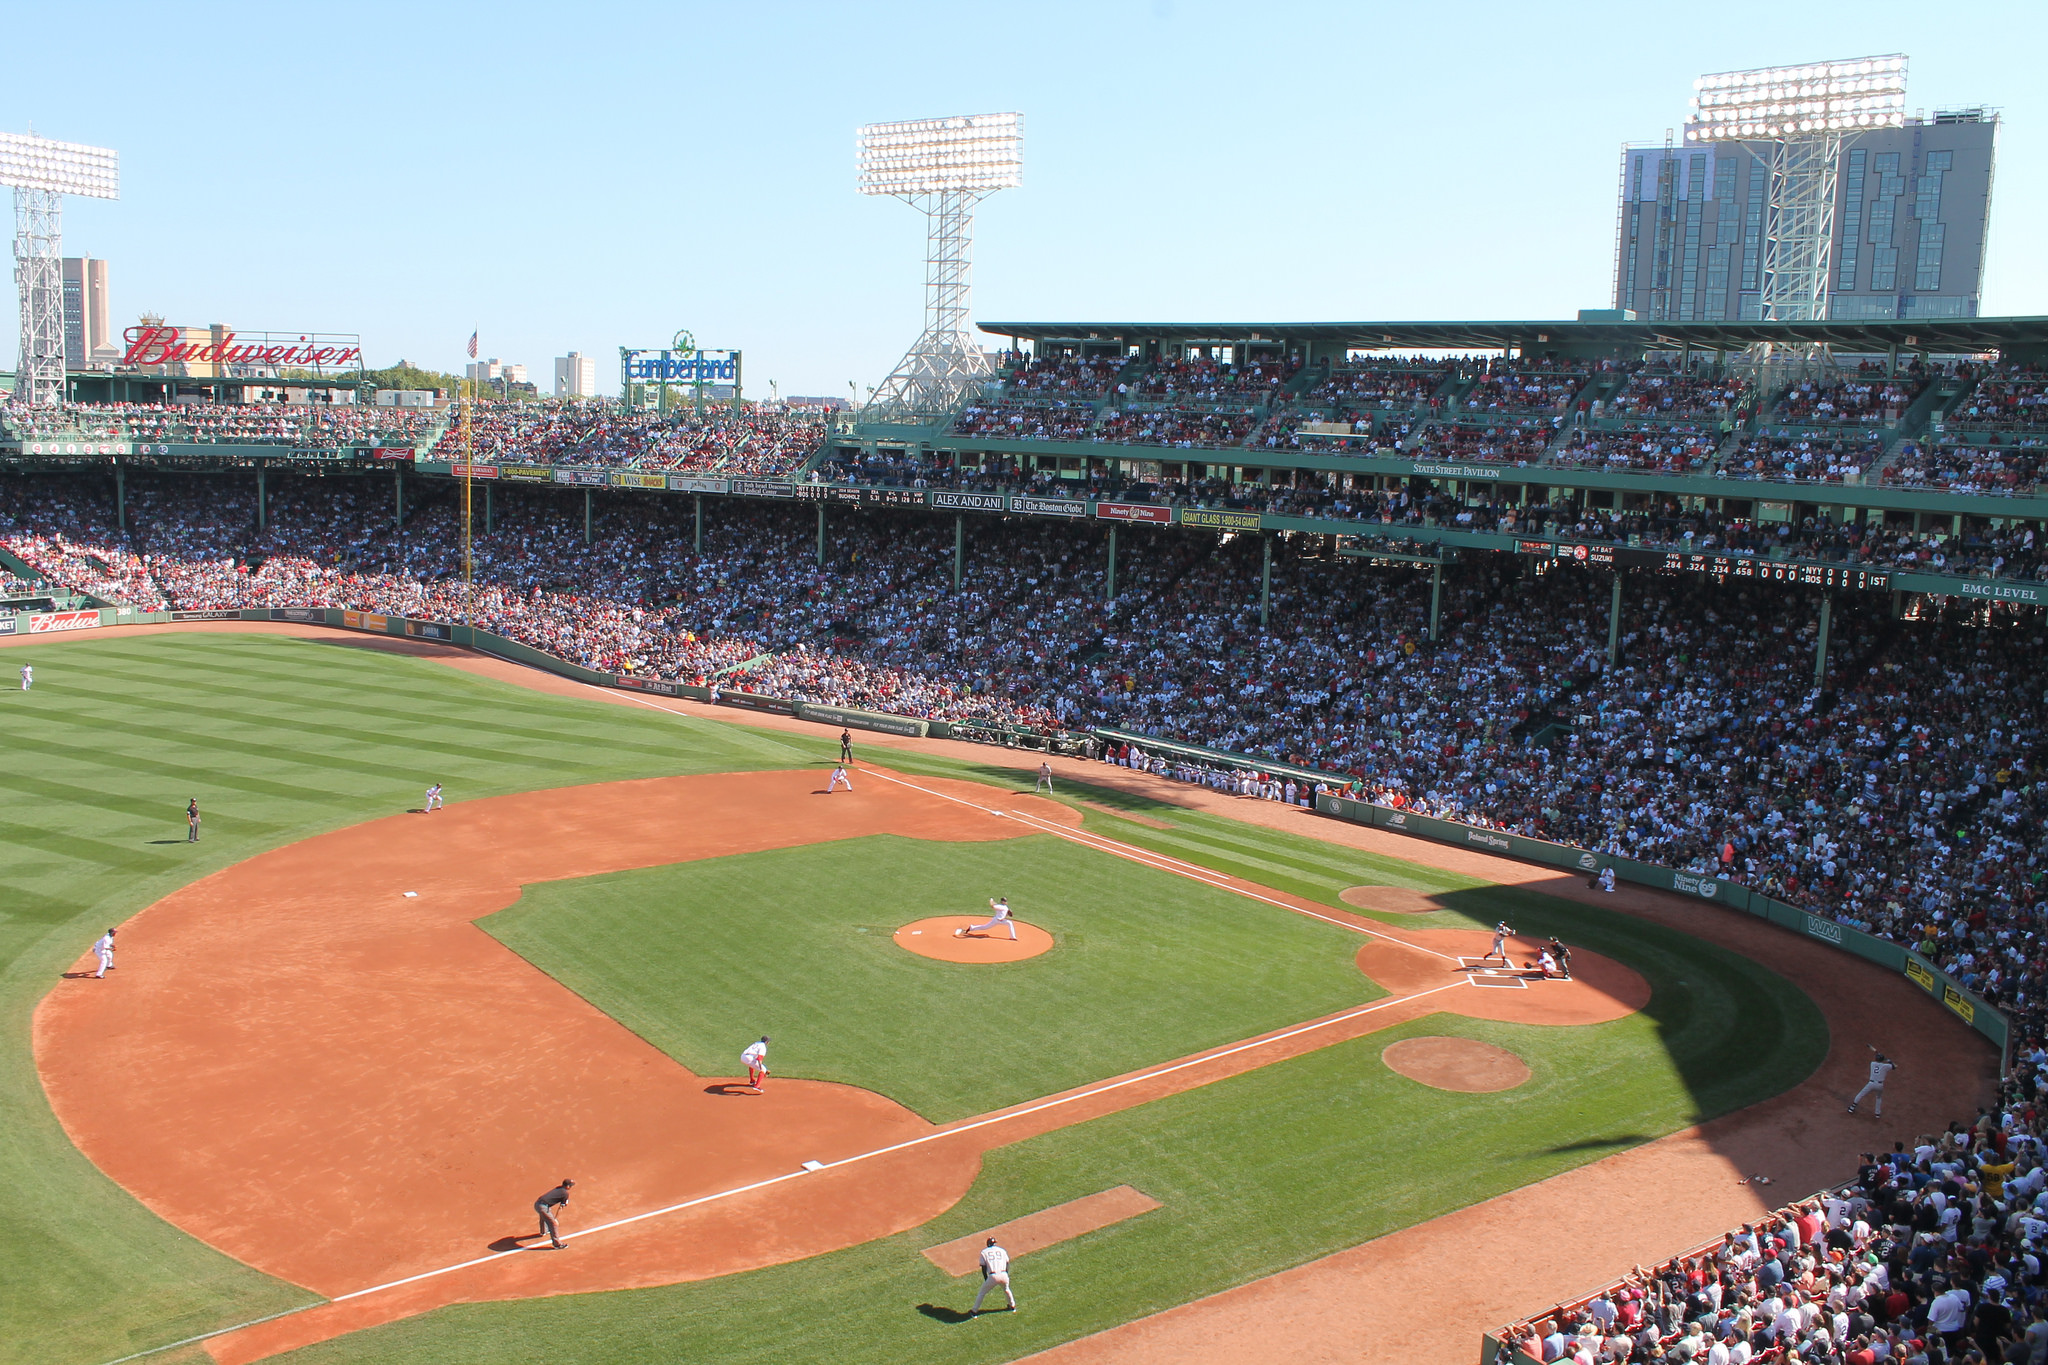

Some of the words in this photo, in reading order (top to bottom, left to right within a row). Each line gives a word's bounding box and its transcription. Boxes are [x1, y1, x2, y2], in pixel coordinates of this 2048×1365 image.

[123, 326, 359, 365] Budweiser
[625, 351, 737, 379] Cumberland
[502, 468, 550, 477] 1-800-PAVEMENT
[1413, 463, 1434, 473] STATE
[1436, 465, 1462, 475] STREET
[1463, 467, 1500, 478] PAVILION
[935, 494, 960, 505] ALEX
[960, 496, 981, 507] AND
[982, 498, 1000, 508] ANI
[1026, 501, 1038, 510] The
[1038, 502, 1062, 512] Boston
[1063, 504, 1082, 514] Globe
[1110, 507, 1129, 517] Ninety
[1184, 512, 1200, 522] GIANT
[1201, 514, 1220, 524] GLASS
[1663, 561, 1680, 569] .284
[1686, 563, 1704, 571] .324
[1710, 565, 1728, 573] .334
[1733, 567, 1751, 575] .658
[1761, 568, 1768, 578] 0
[1775, 569, 1782, 579] 0
[1788, 570, 1795, 580] 0
[1806, 567, 1822, 575] NYY
[1962, 584, 1991, 595] EMC
[1994, 587, 2037, 600] LEVEL
[117, 608, 131, 616] 380
[662, 684, 672, 692] Bat
[1468, 831, 1488, 842] Poland
[1488, 836, 1508, 848] Spring
[1675, 873, 1700, 885] Ninety
[1674, 880, 1697, 893] Nine
[1808, 916, 1841, 940] WM
[1840, 1207, 1846, 1215] 2
[987, 1251, 1002, 1261] 59
[1882, 1248, 1889, 1256] 2
[1671, 1281, 1679, 1290] 2
[1842, 1326, 1846, 1335] 2
